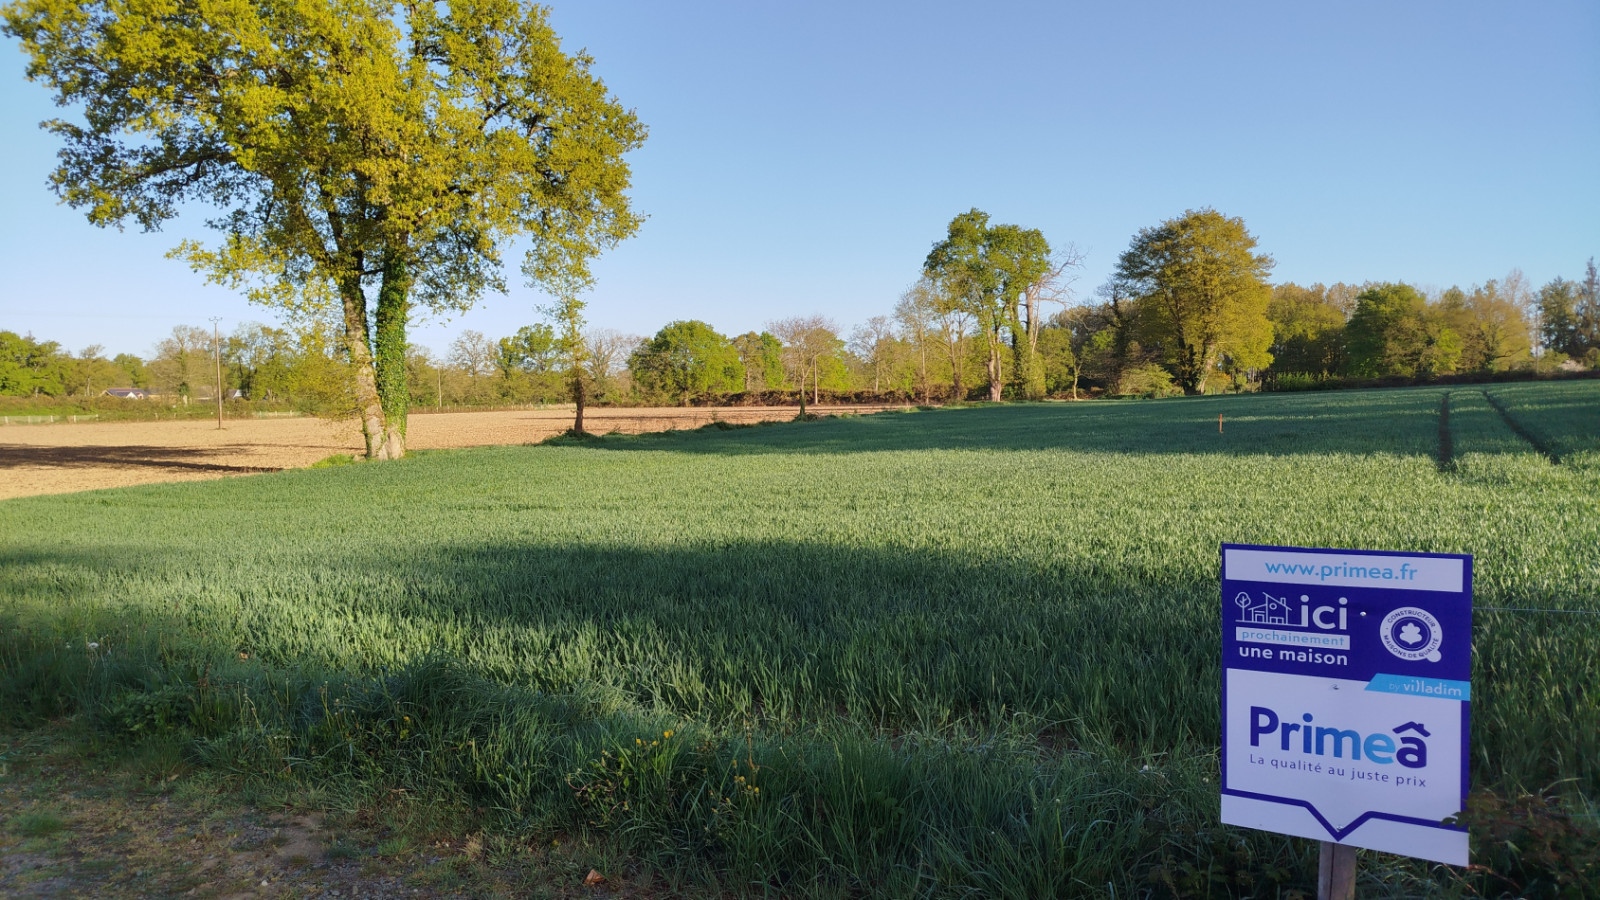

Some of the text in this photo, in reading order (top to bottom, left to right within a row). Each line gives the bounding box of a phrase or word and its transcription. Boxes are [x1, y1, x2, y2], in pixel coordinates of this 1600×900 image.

[1265, 562, 1418, 581] www.primea.fr
[1300, 594, 1348, 630] ici
[1387, 610, 1436, 627] CONSTRUCTEUR
[1241, 630, 1345, 646] prochainement
[1384, 635, 1407, 657] MAISONS
[1239, 646, 1348, 666] une maison
[1389, 682, 1400, 691] by
[1250, 753, 1426, 787] La qualité au juste prix
